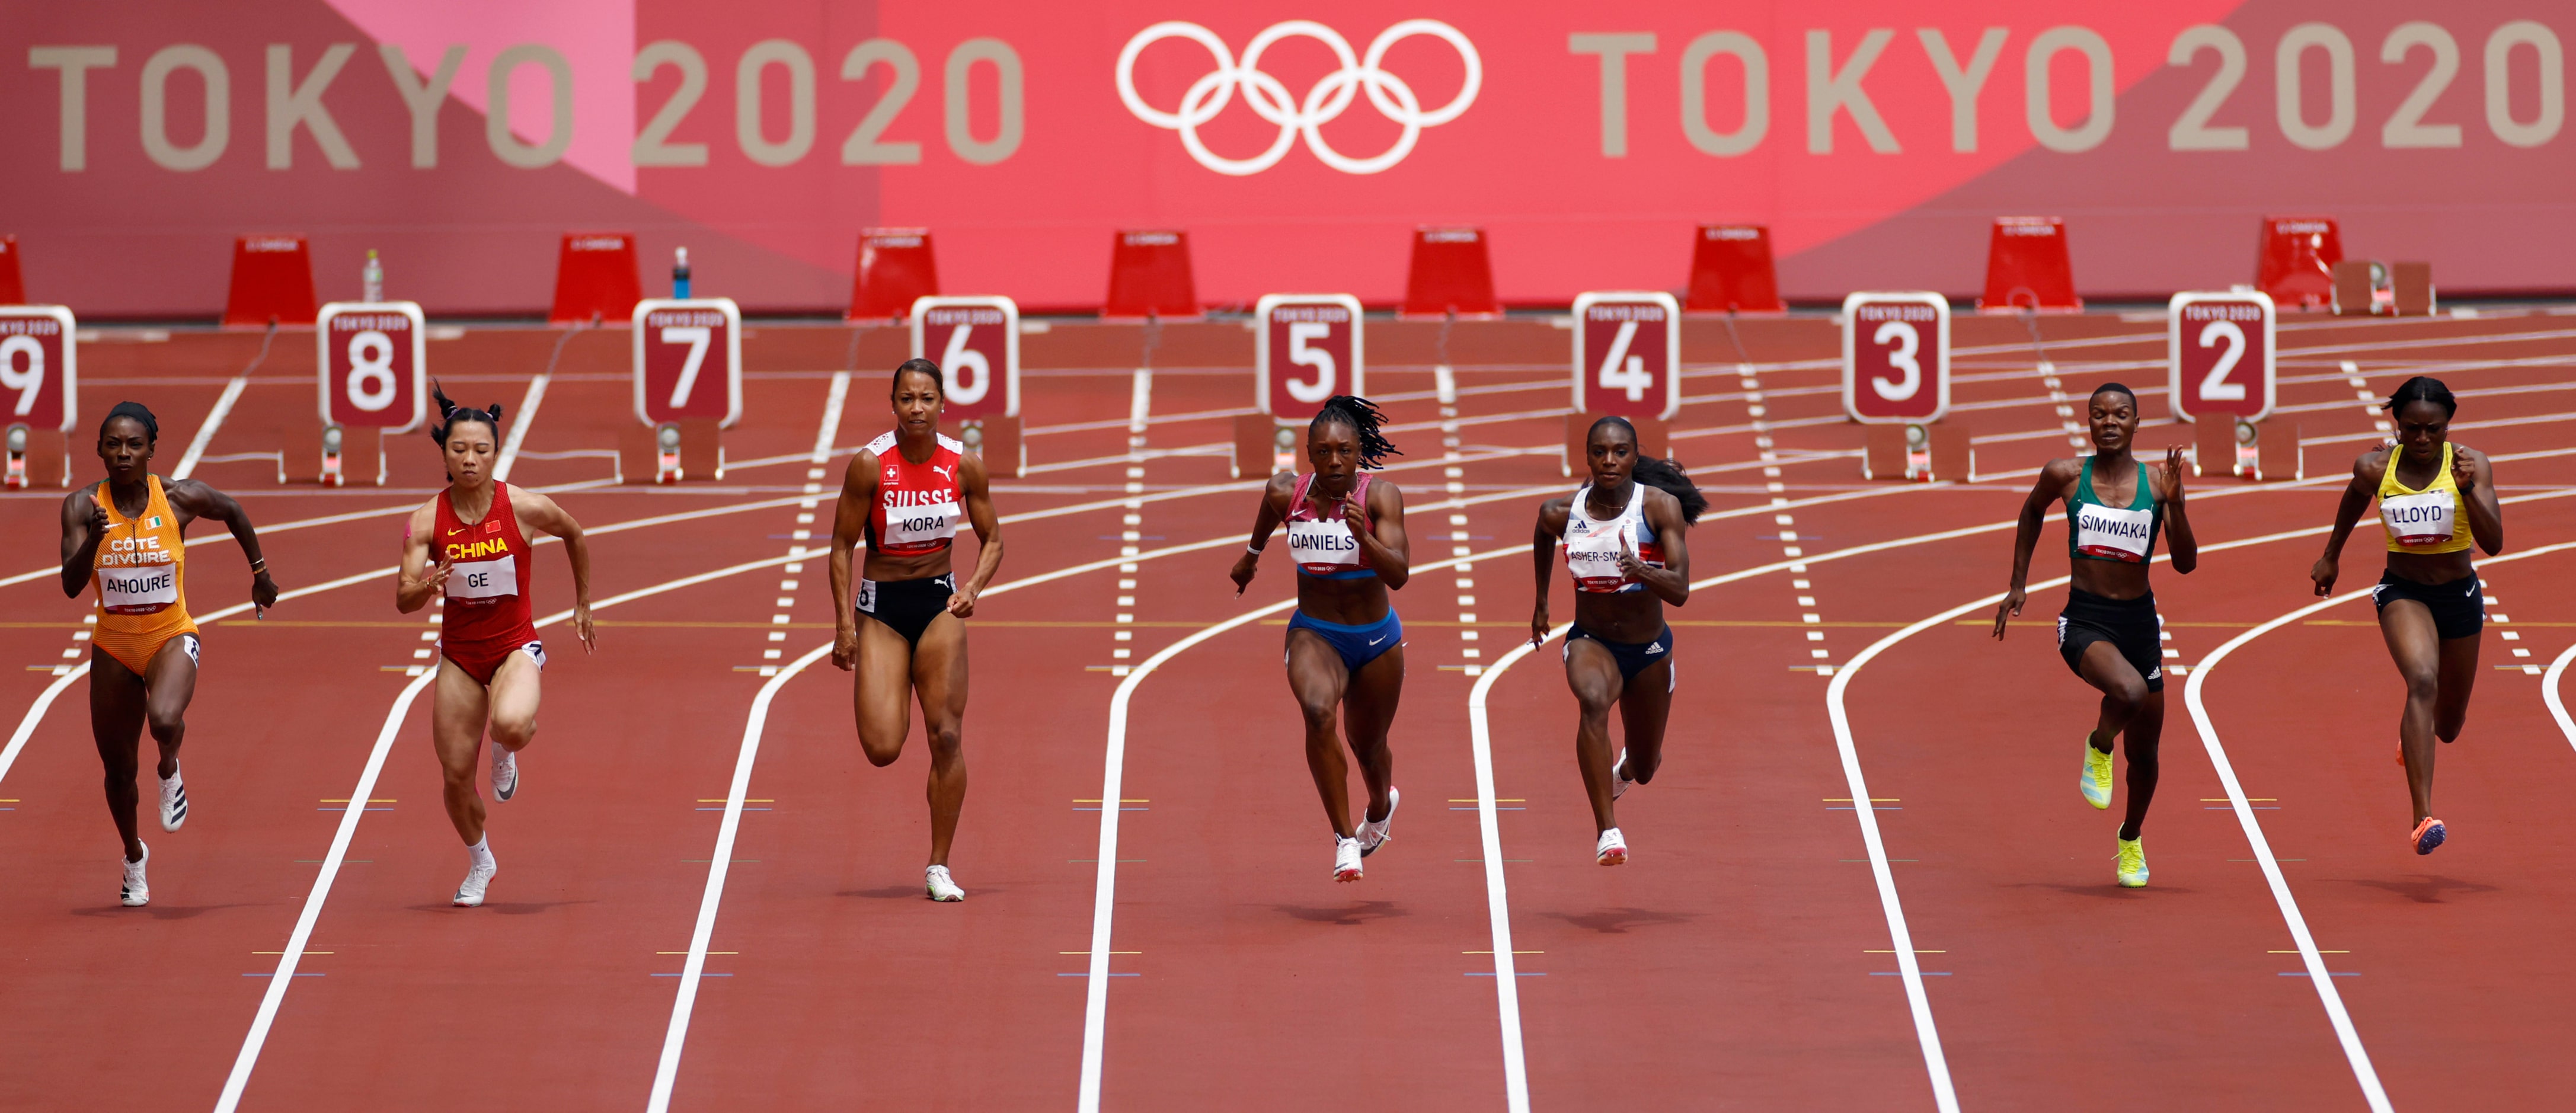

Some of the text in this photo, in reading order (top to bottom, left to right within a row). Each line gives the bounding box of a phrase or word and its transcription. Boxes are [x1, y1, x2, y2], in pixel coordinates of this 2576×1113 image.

[1568, 20, 2565, 158] TOKYO 2020
[29, 39, 1024, 171] TOKYO 2020
[648, 312, 724, 328] TOKYO 2020
[928, 309, 1003, 325] TOKYO 2020
[1274, 307, 1348, 322] TOKYO 2020
[1589, 306, 1663, 321] TOKYO 2020
[1860, 306, 1934, 321] TOKYO 2020
[2185, 305, 2261, 321] TOKYO 2020
[28, 321, 58, 335] 2020
[333, 316, 408, 331] TOKYO 2020
[347, 331, 397, 411] 8
[661, 328, 711, 408] 7
[941, 325, 989, 405] 6
[1286, 322, 1336, 403] 5
[1599, 321, 1653, 402] 4
[1871, 321, 1921, 401] 3
[2198, 321, 2246, 401] 2
[0, 335, 44, 415] 9
[883, 488, 952, 509] SUISSE
[902, 516, 944, 532] KORA
[2392, 506, 2441, 523] LLOYD
[2081, 514, 2147, 540] SIMWAKA
[111, 536, 160, 551] CÔTE
[447, 537, 508, 559] CHINA
[1292, 533, 1355, 551] DANIELS
[107, 574, 171, 594] AHOURE
[468, 573, 488, 587] GE
[859, 582, 869, 606] 6
